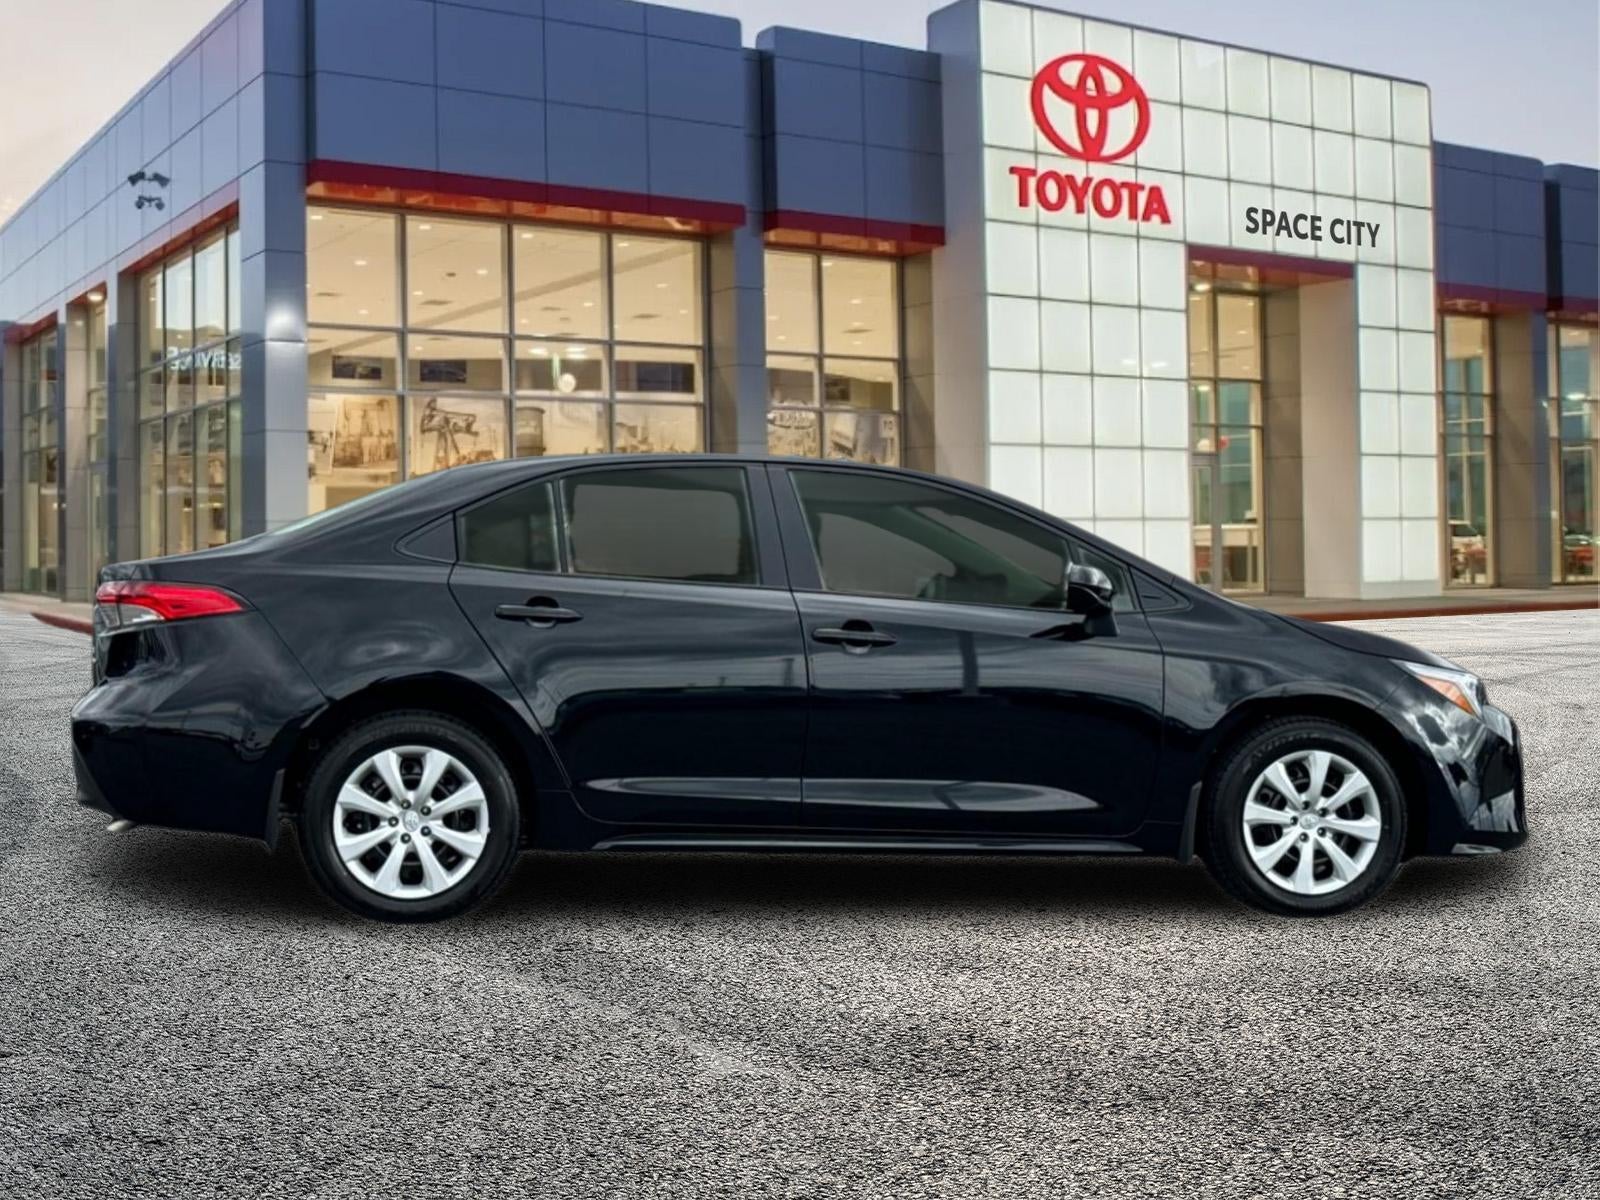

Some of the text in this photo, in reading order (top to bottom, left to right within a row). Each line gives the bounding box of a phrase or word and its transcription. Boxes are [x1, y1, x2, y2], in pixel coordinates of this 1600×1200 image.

[1009, 166, 1171, 225] TOYOTA
[1245, 206, 1380, 248] SPACE CITY
